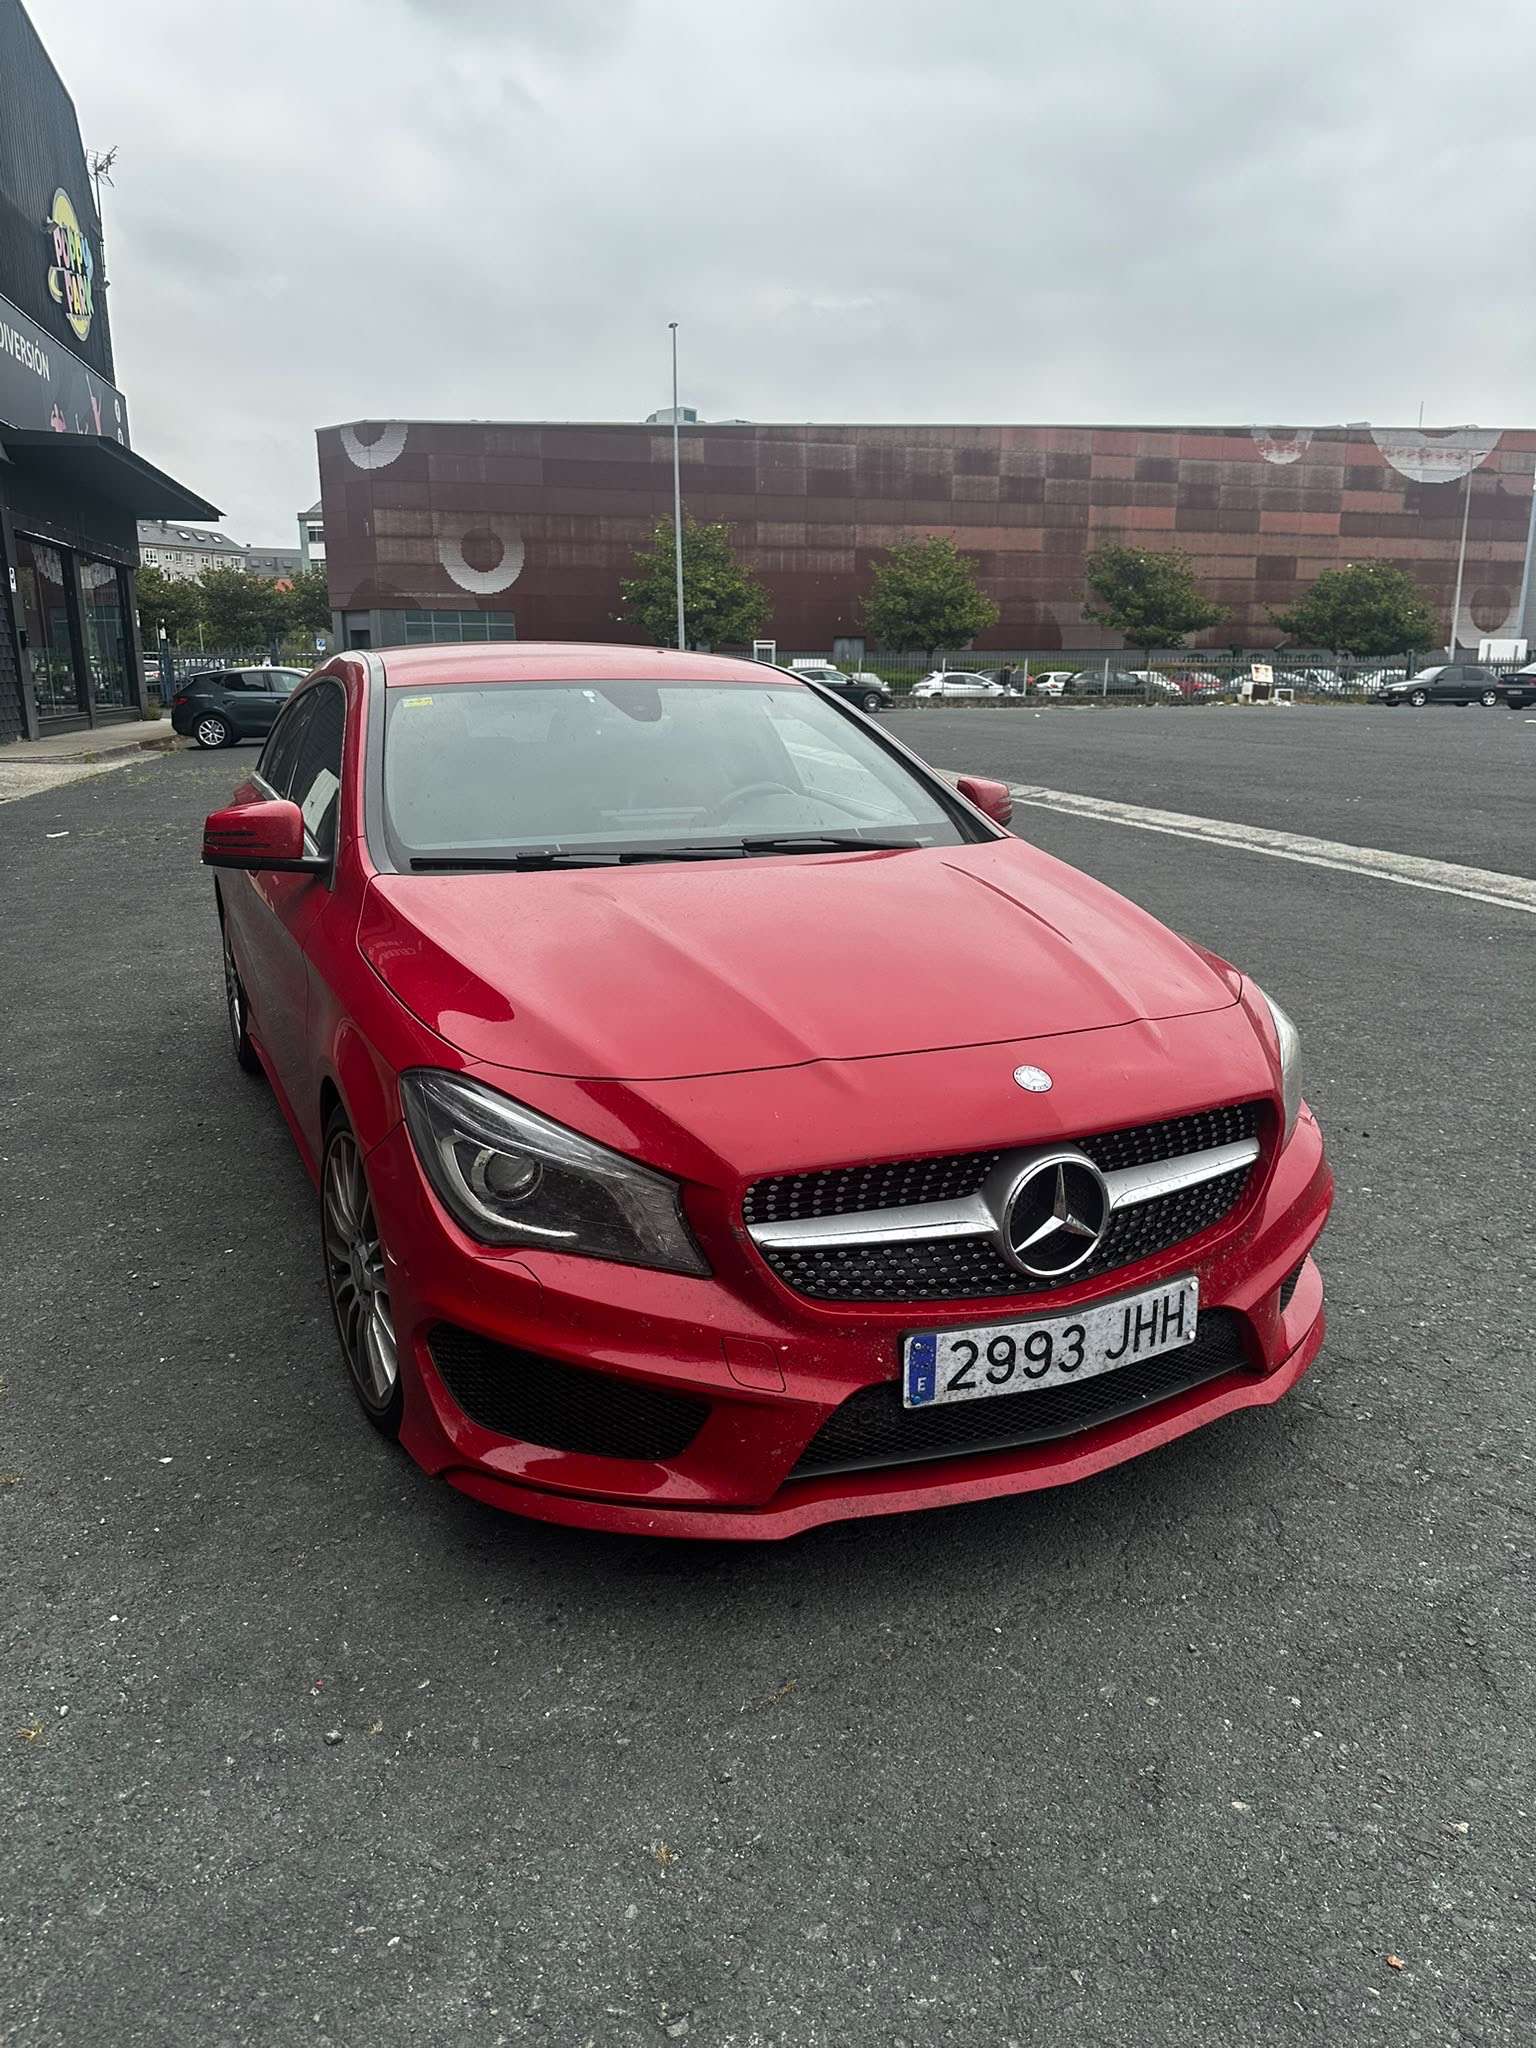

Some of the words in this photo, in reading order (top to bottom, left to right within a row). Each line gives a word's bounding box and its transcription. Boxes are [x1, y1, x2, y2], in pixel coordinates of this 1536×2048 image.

[64, 270, 94, 316] PARK
[947, 1324, 1086, 1391] 2993
[1105, 1290, 1185, 1360] JHH
[917, 1377, 926, 1392] E
